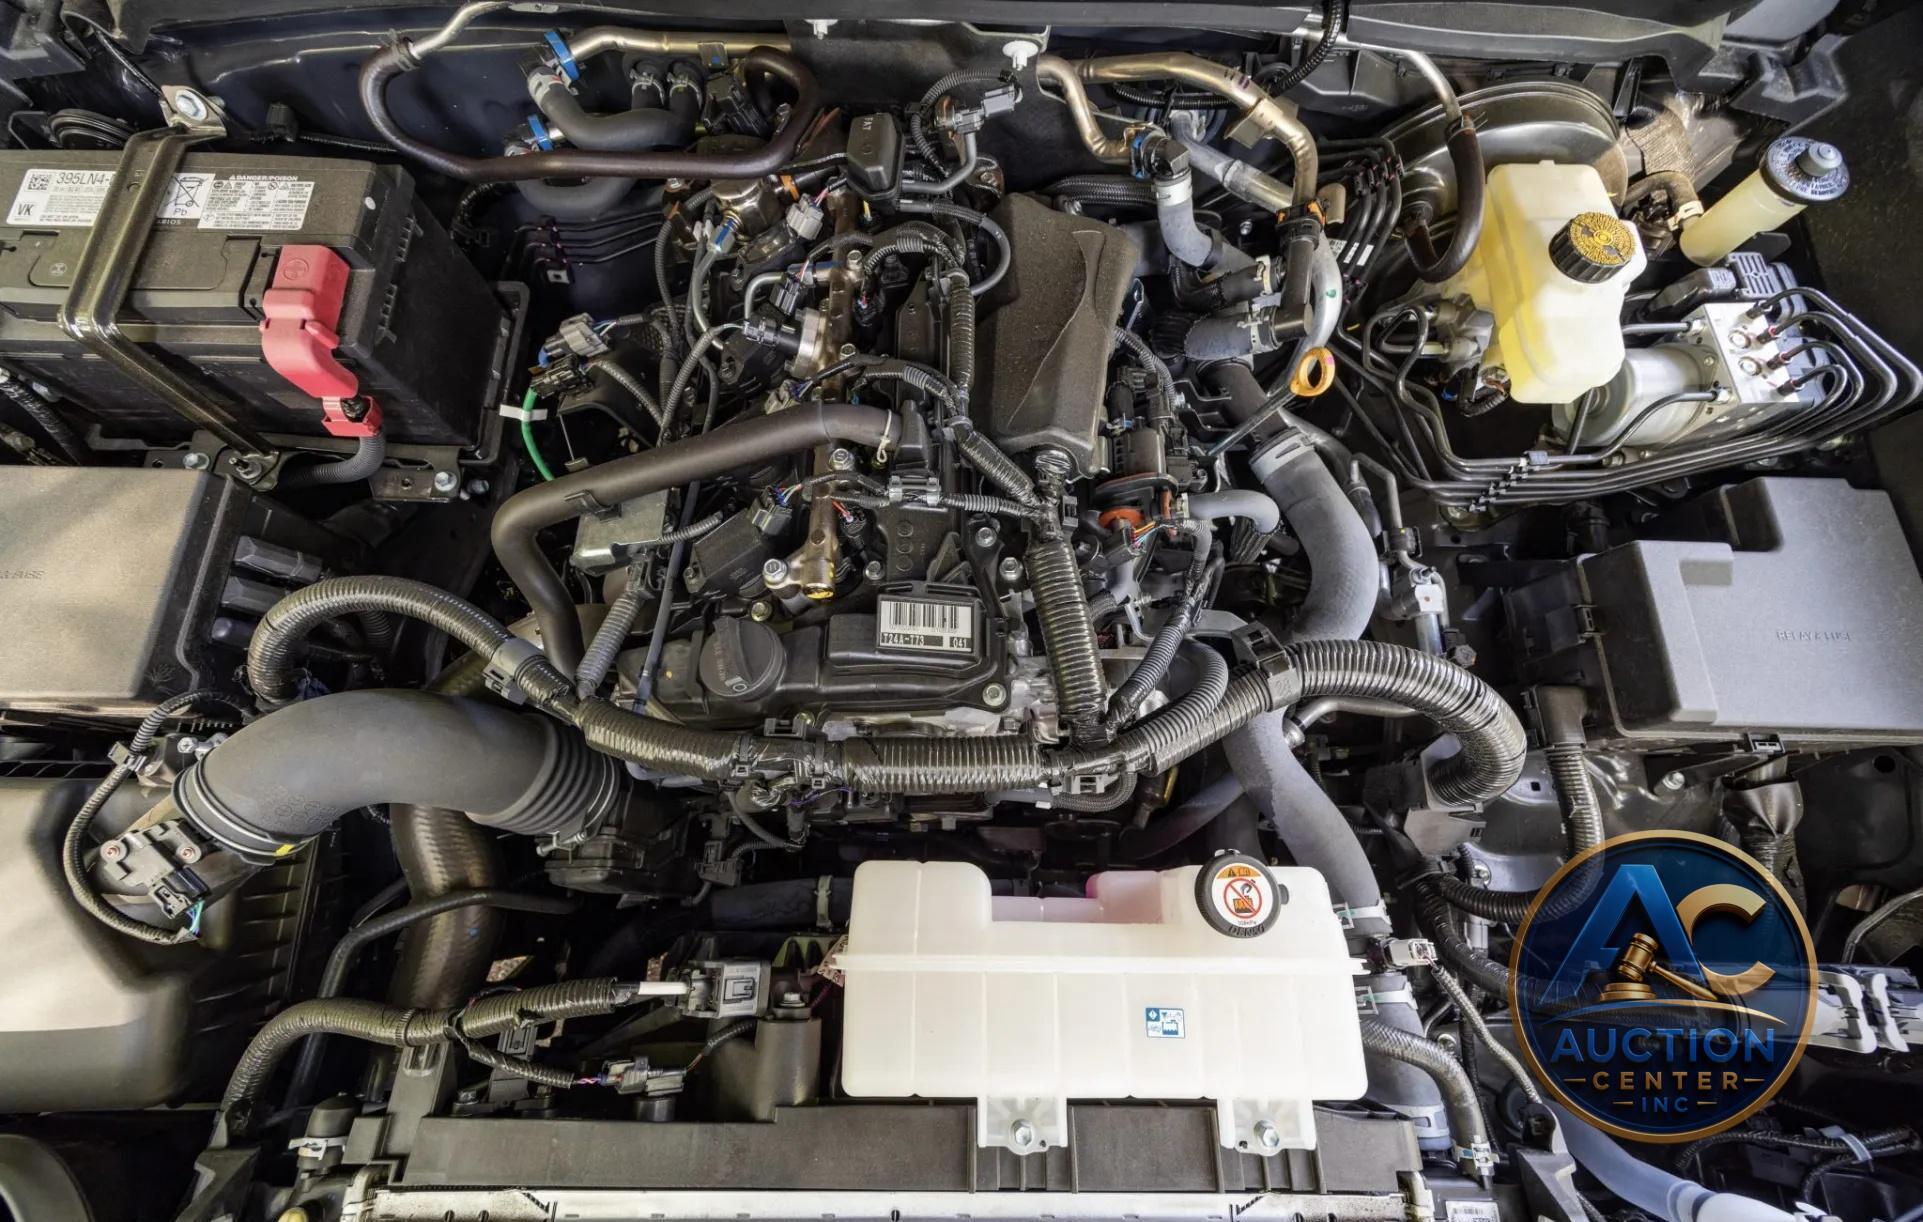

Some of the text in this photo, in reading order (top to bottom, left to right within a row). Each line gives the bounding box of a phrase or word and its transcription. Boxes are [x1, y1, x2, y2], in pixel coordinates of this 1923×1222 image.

[57, 172, 115, 184] 395LN4-
[18, 203, 34, 216] VK
[173, 207, 188, 216] Pb
[883, 633, 967, 648] T24A-T73 041
[1229, 924, 1265, 937] DENSO
